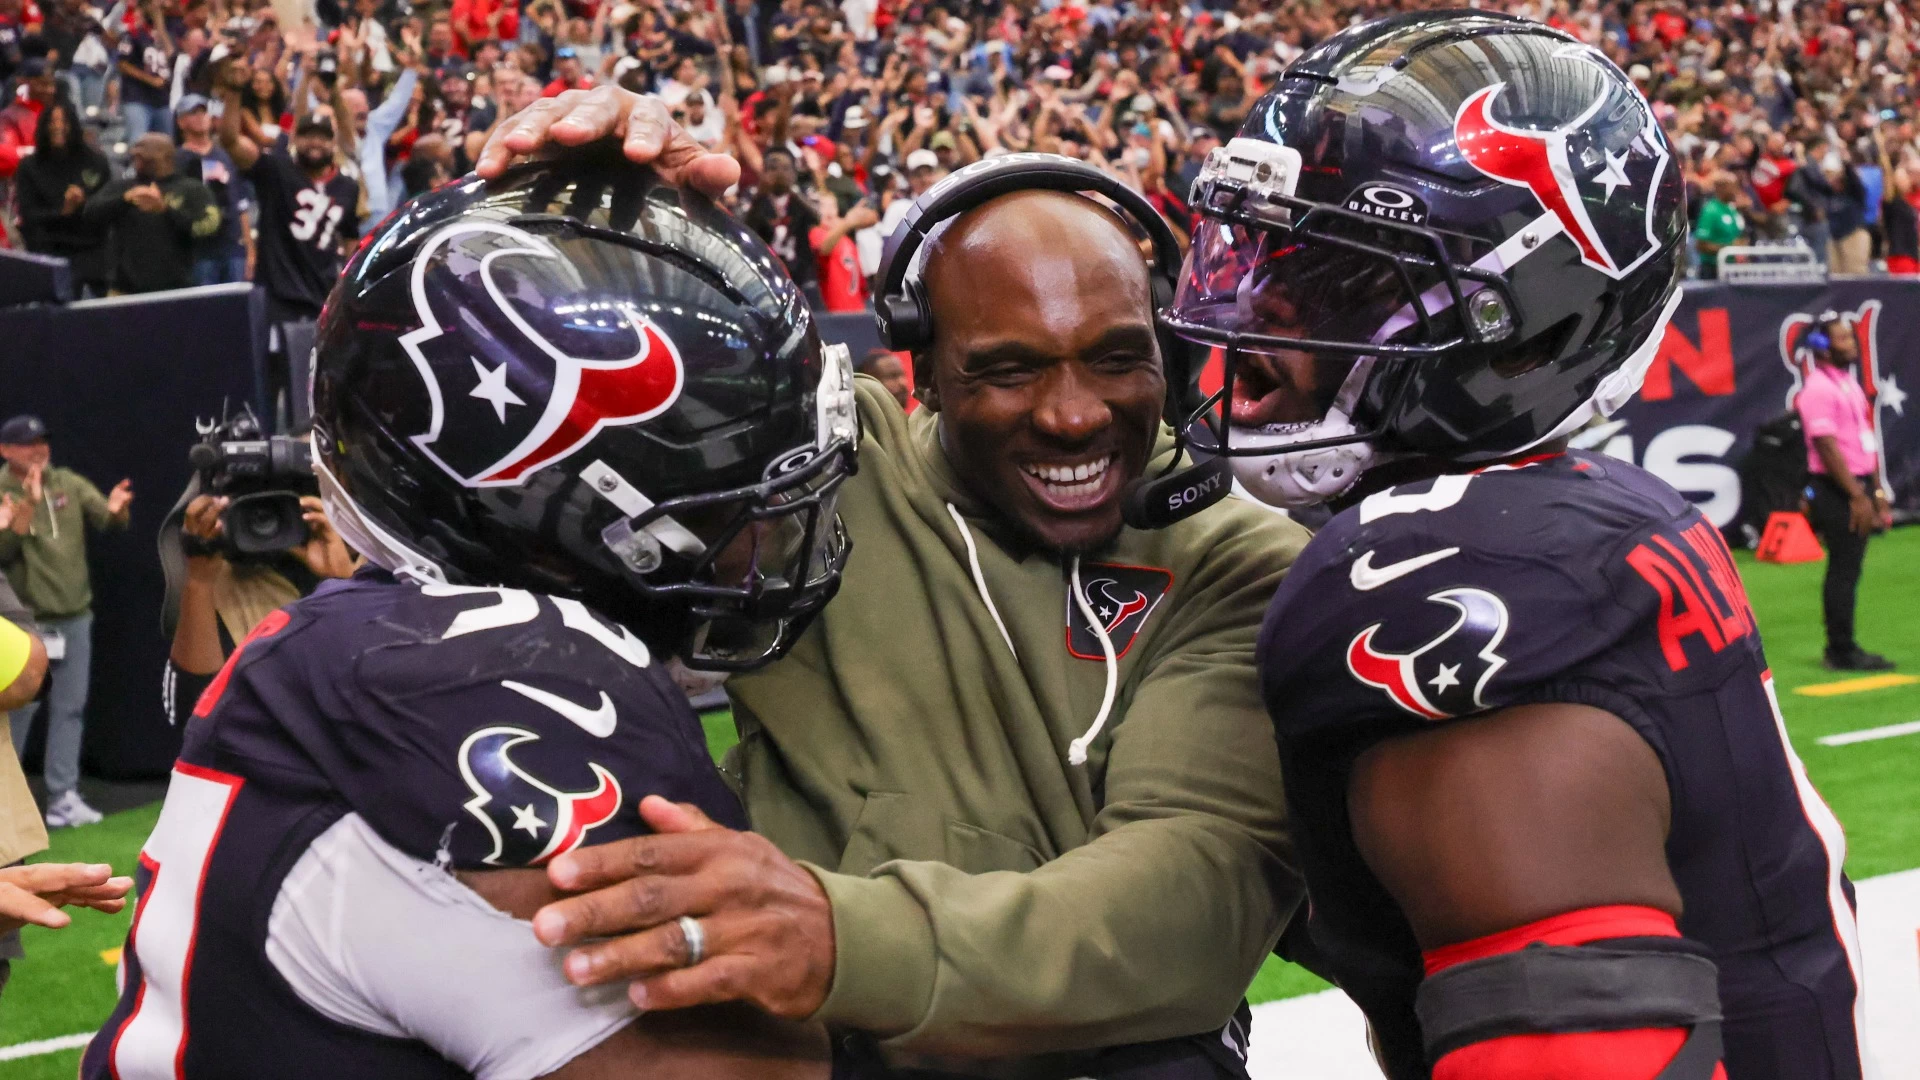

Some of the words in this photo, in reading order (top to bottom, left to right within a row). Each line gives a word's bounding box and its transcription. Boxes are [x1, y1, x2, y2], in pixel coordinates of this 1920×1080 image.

[289, 188, 344, 250] 31
[1348, 200, 1422, 223] OAKLEY
[1639, 308, 1737, 402] N
[1168, 472, 1221, 511] SONY
